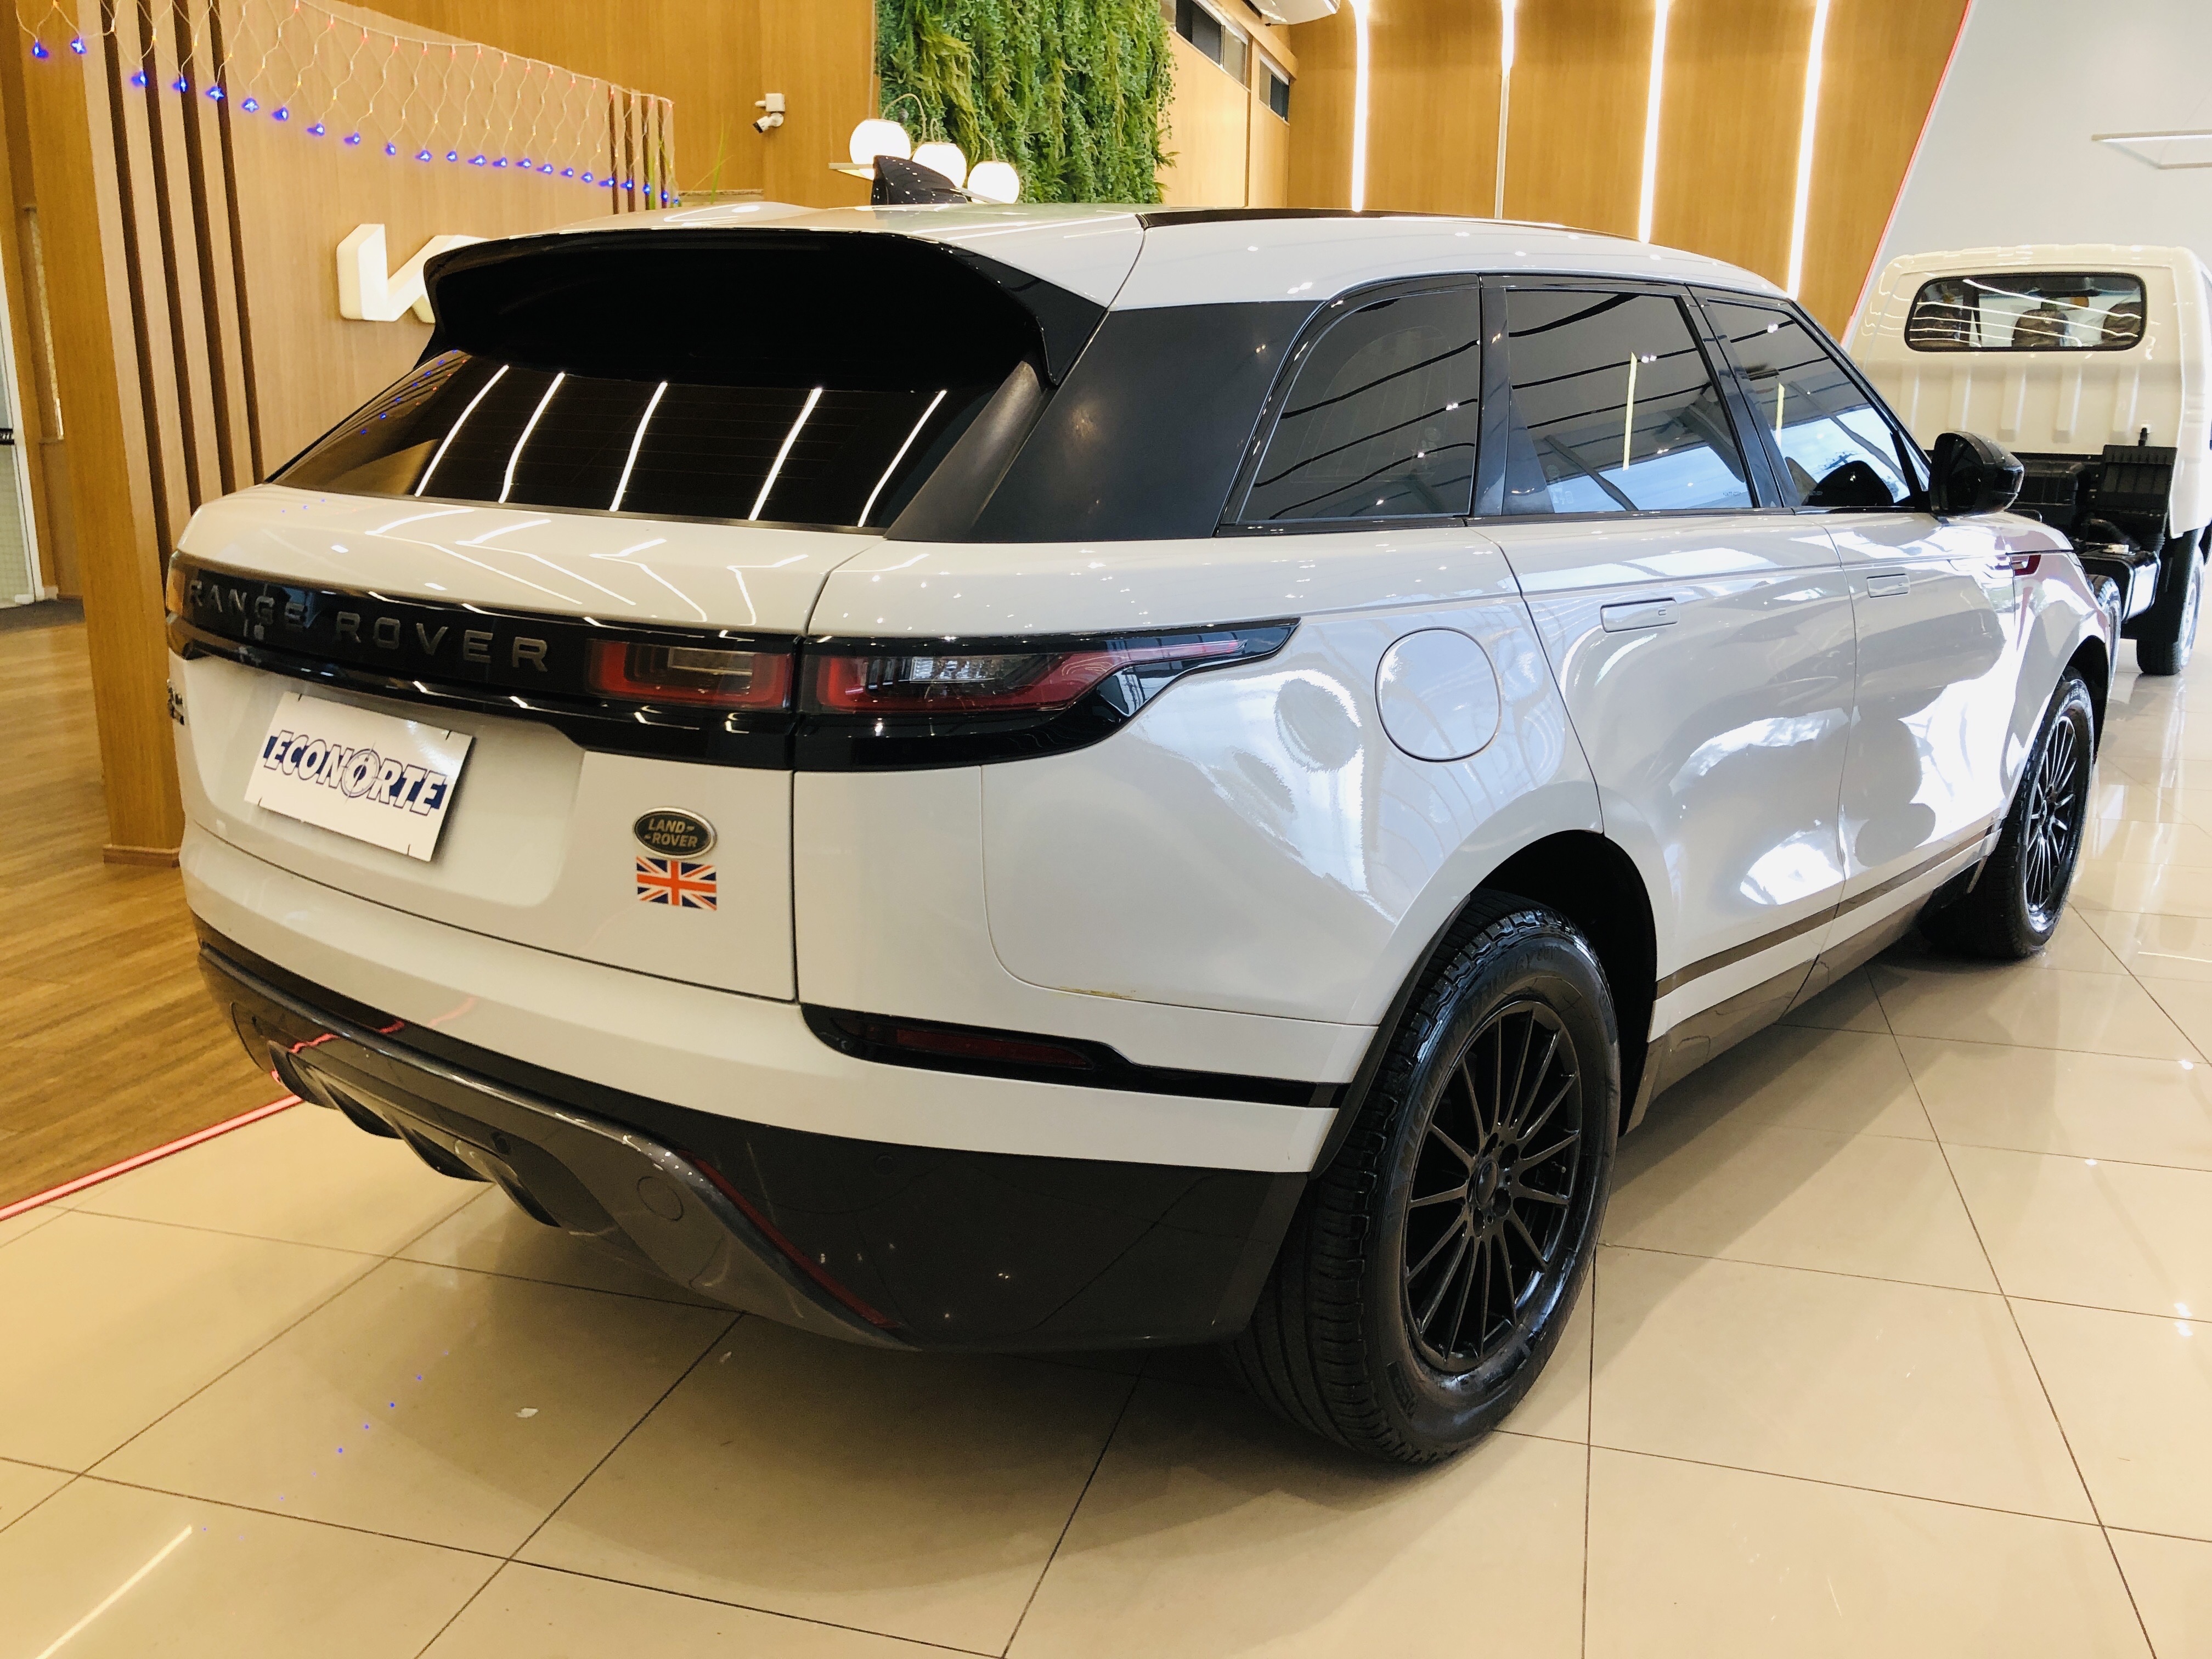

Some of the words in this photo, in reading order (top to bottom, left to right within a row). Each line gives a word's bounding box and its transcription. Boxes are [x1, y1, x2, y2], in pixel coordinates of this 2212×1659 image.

[189, 579, 305, 627] RANGE
[336, 611, 548, 673] ROVER
[264, 730, 447, 816] ECONORTE
